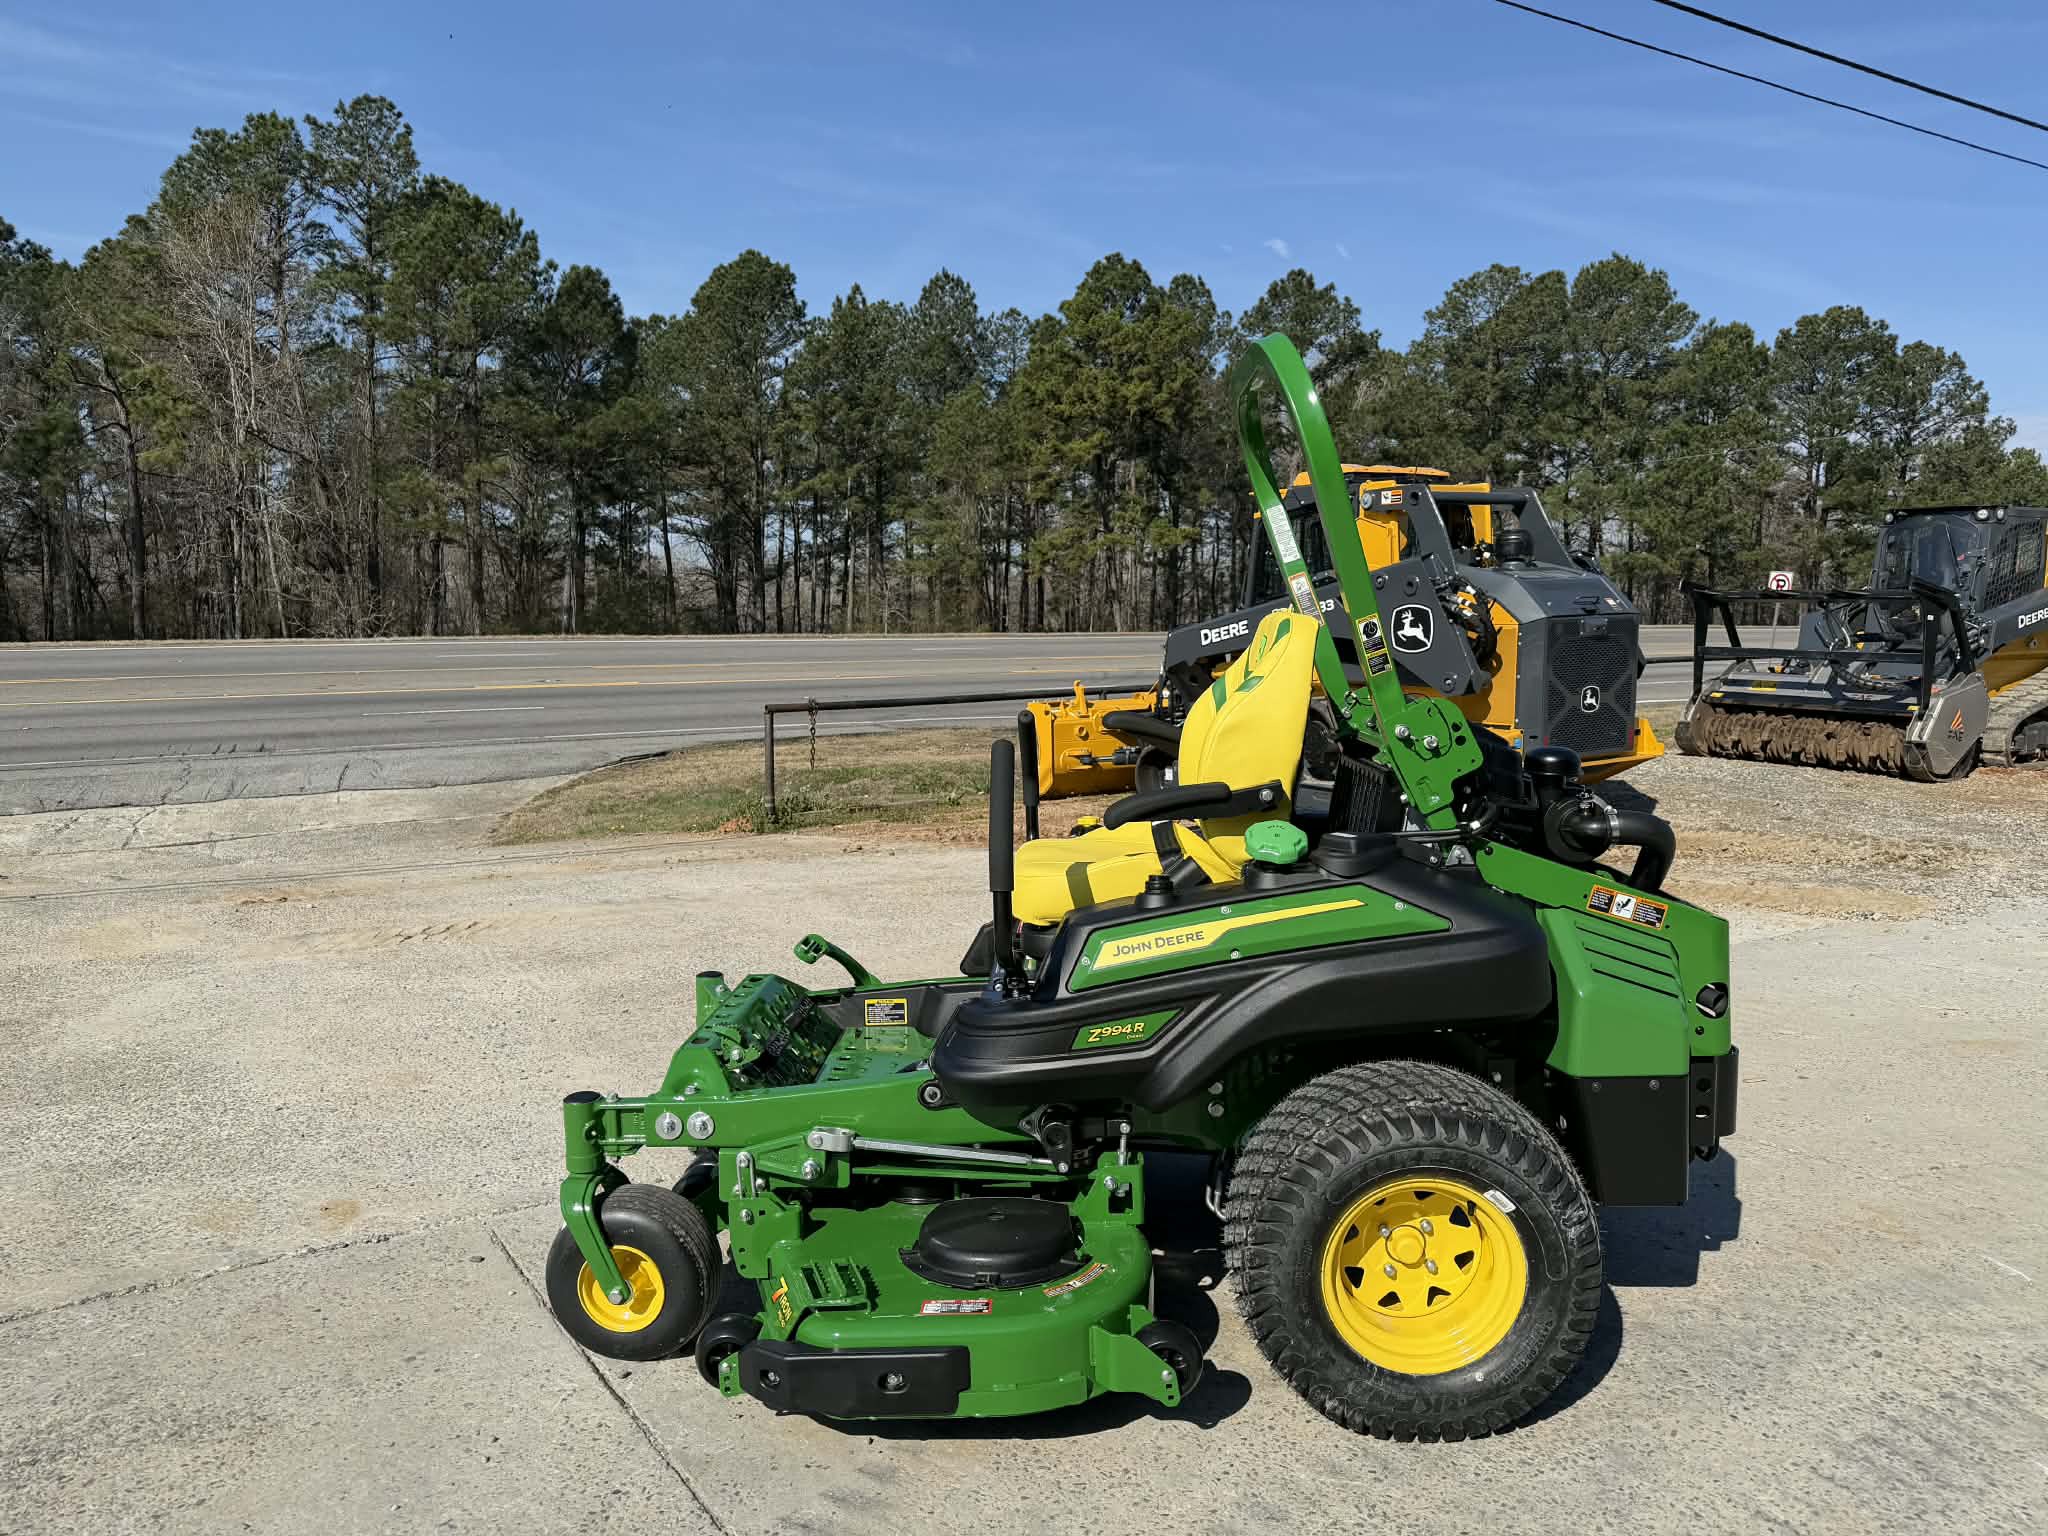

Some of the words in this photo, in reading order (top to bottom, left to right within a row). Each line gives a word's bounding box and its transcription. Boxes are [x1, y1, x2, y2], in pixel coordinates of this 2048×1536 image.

[2018, 607, 2048, 629] DEERE
[1200, 619, 1249, 646] DEERE
[1113, 940, 1152, 957] JOHN
[1154, 931, 1205, 949] DEERE
[1087, 1022, 1145, 1043] Z994R
